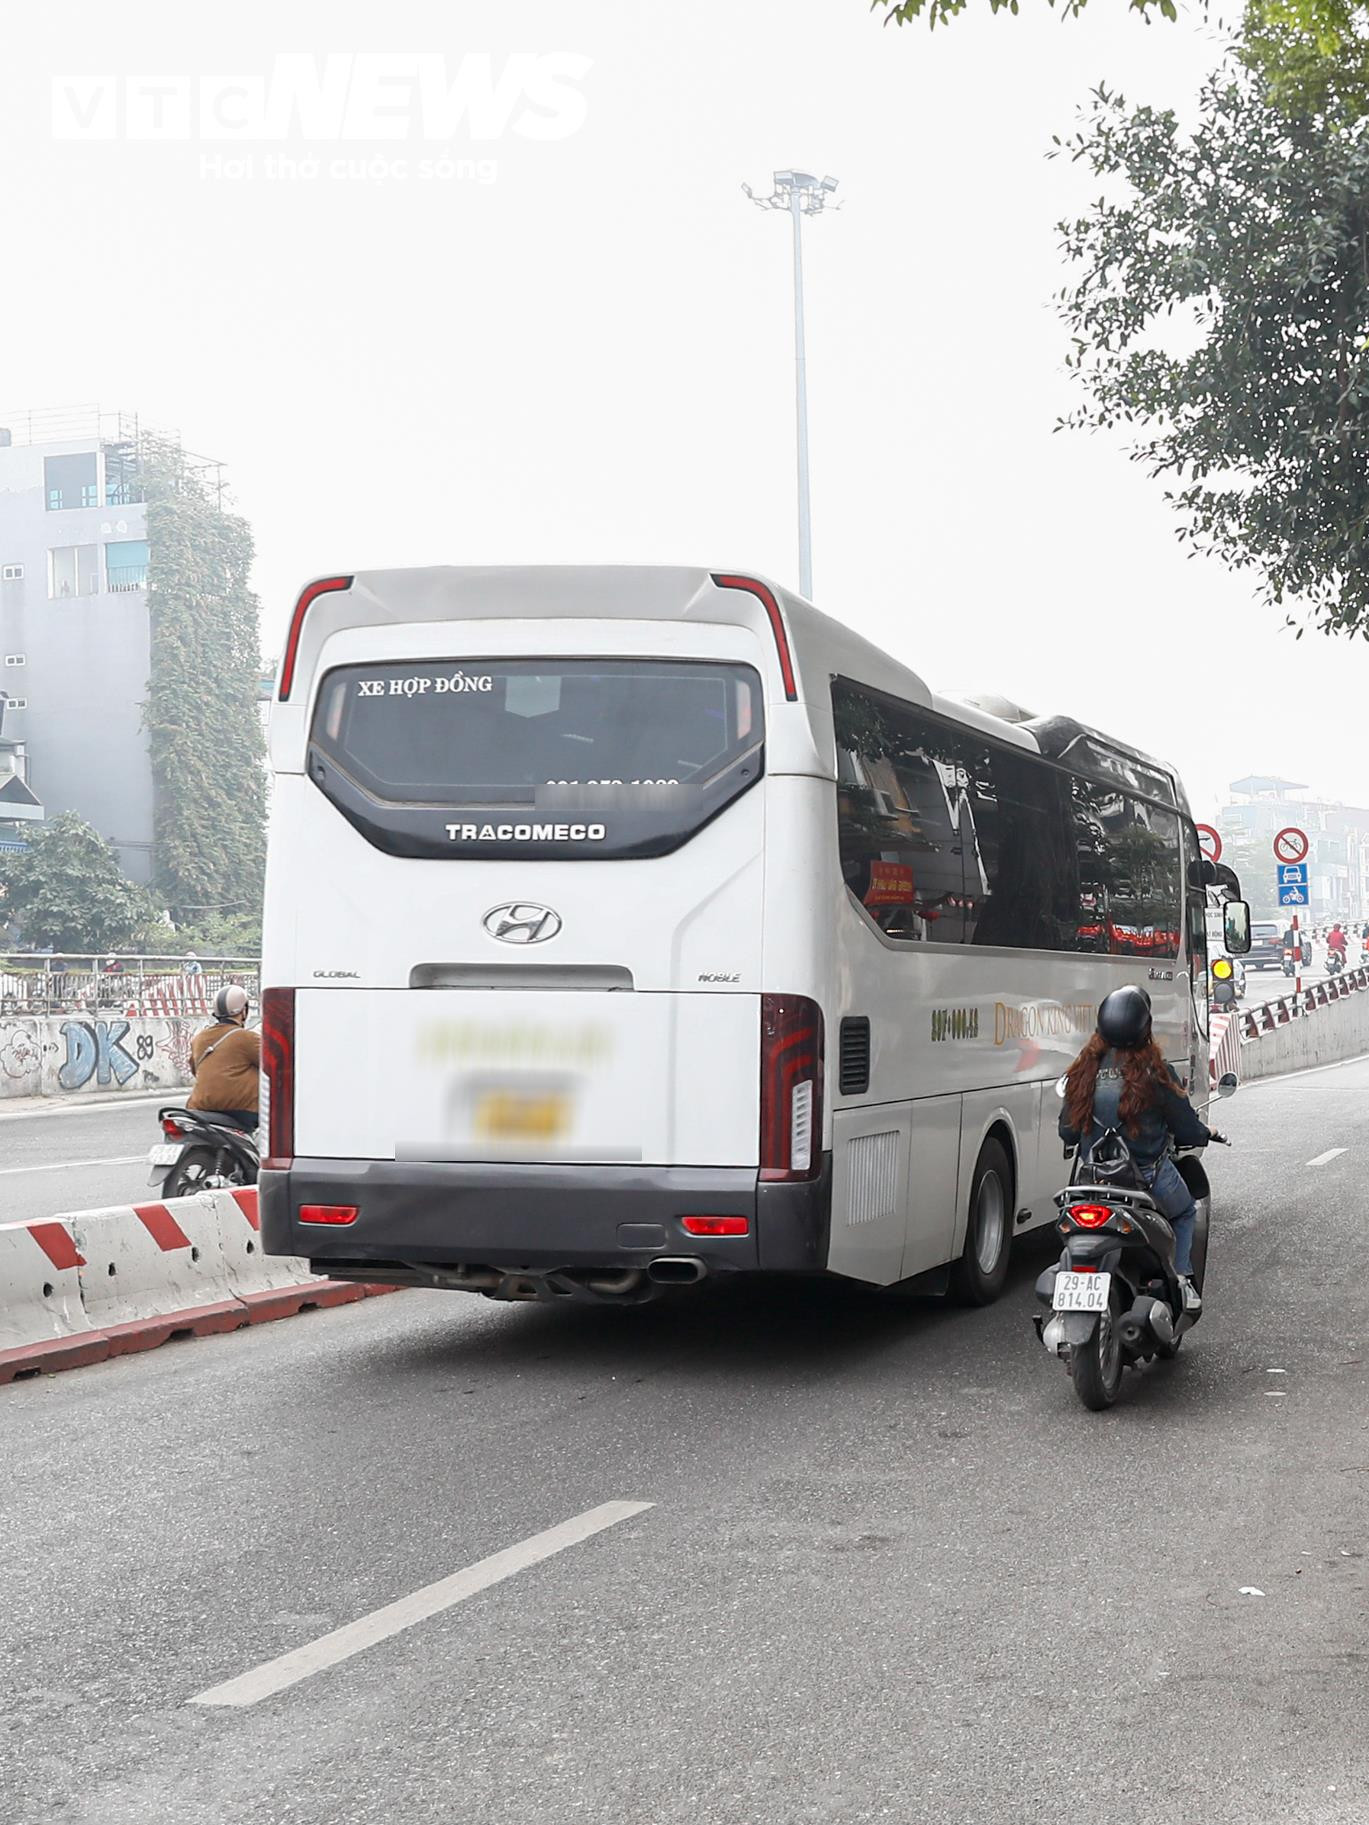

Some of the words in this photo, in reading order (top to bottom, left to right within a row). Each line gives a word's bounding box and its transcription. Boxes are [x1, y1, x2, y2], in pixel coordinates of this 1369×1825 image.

[358, 679, 385, 697] XE
[389, 676, 431, 698] HỢP
[435, 669, 493, 694] ĐỒNG
[445, 823, 606, 842] TRACOMECO
[58, 1021, 140, 1090] DK
[136, 1035, 155, 1061] 89
[1063, 1275, 1102, 1291] 29-AC
[1057, 1292, 1103, 1308] 814.04
